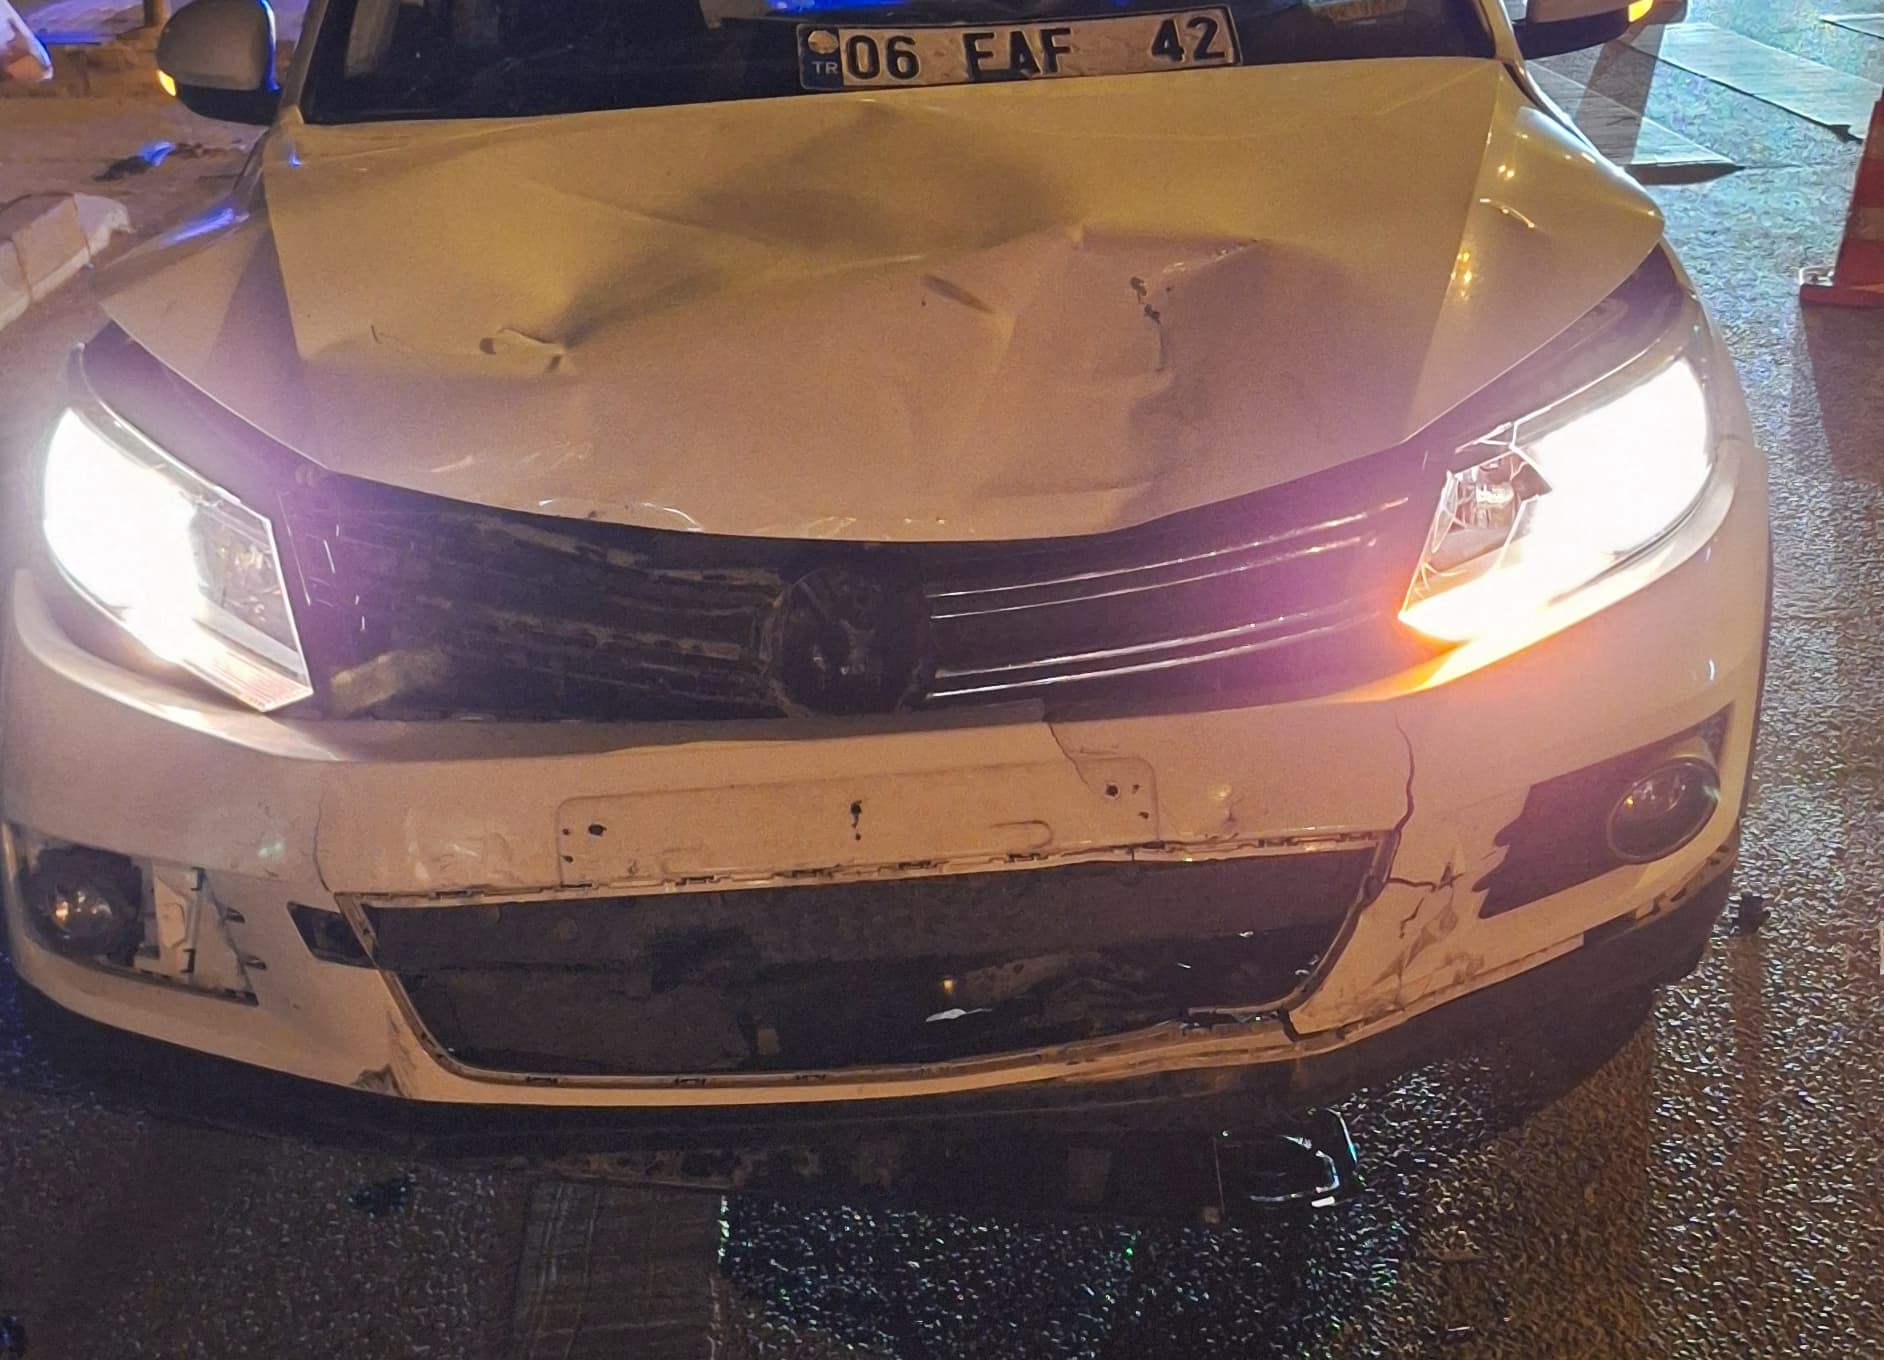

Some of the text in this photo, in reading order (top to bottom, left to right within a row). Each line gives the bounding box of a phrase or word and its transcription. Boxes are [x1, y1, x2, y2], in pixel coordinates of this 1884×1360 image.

[847, 35, 919, 79] 06
[1152, 17, 1224, 61] 42
[812, 61, 838, 74] TR
